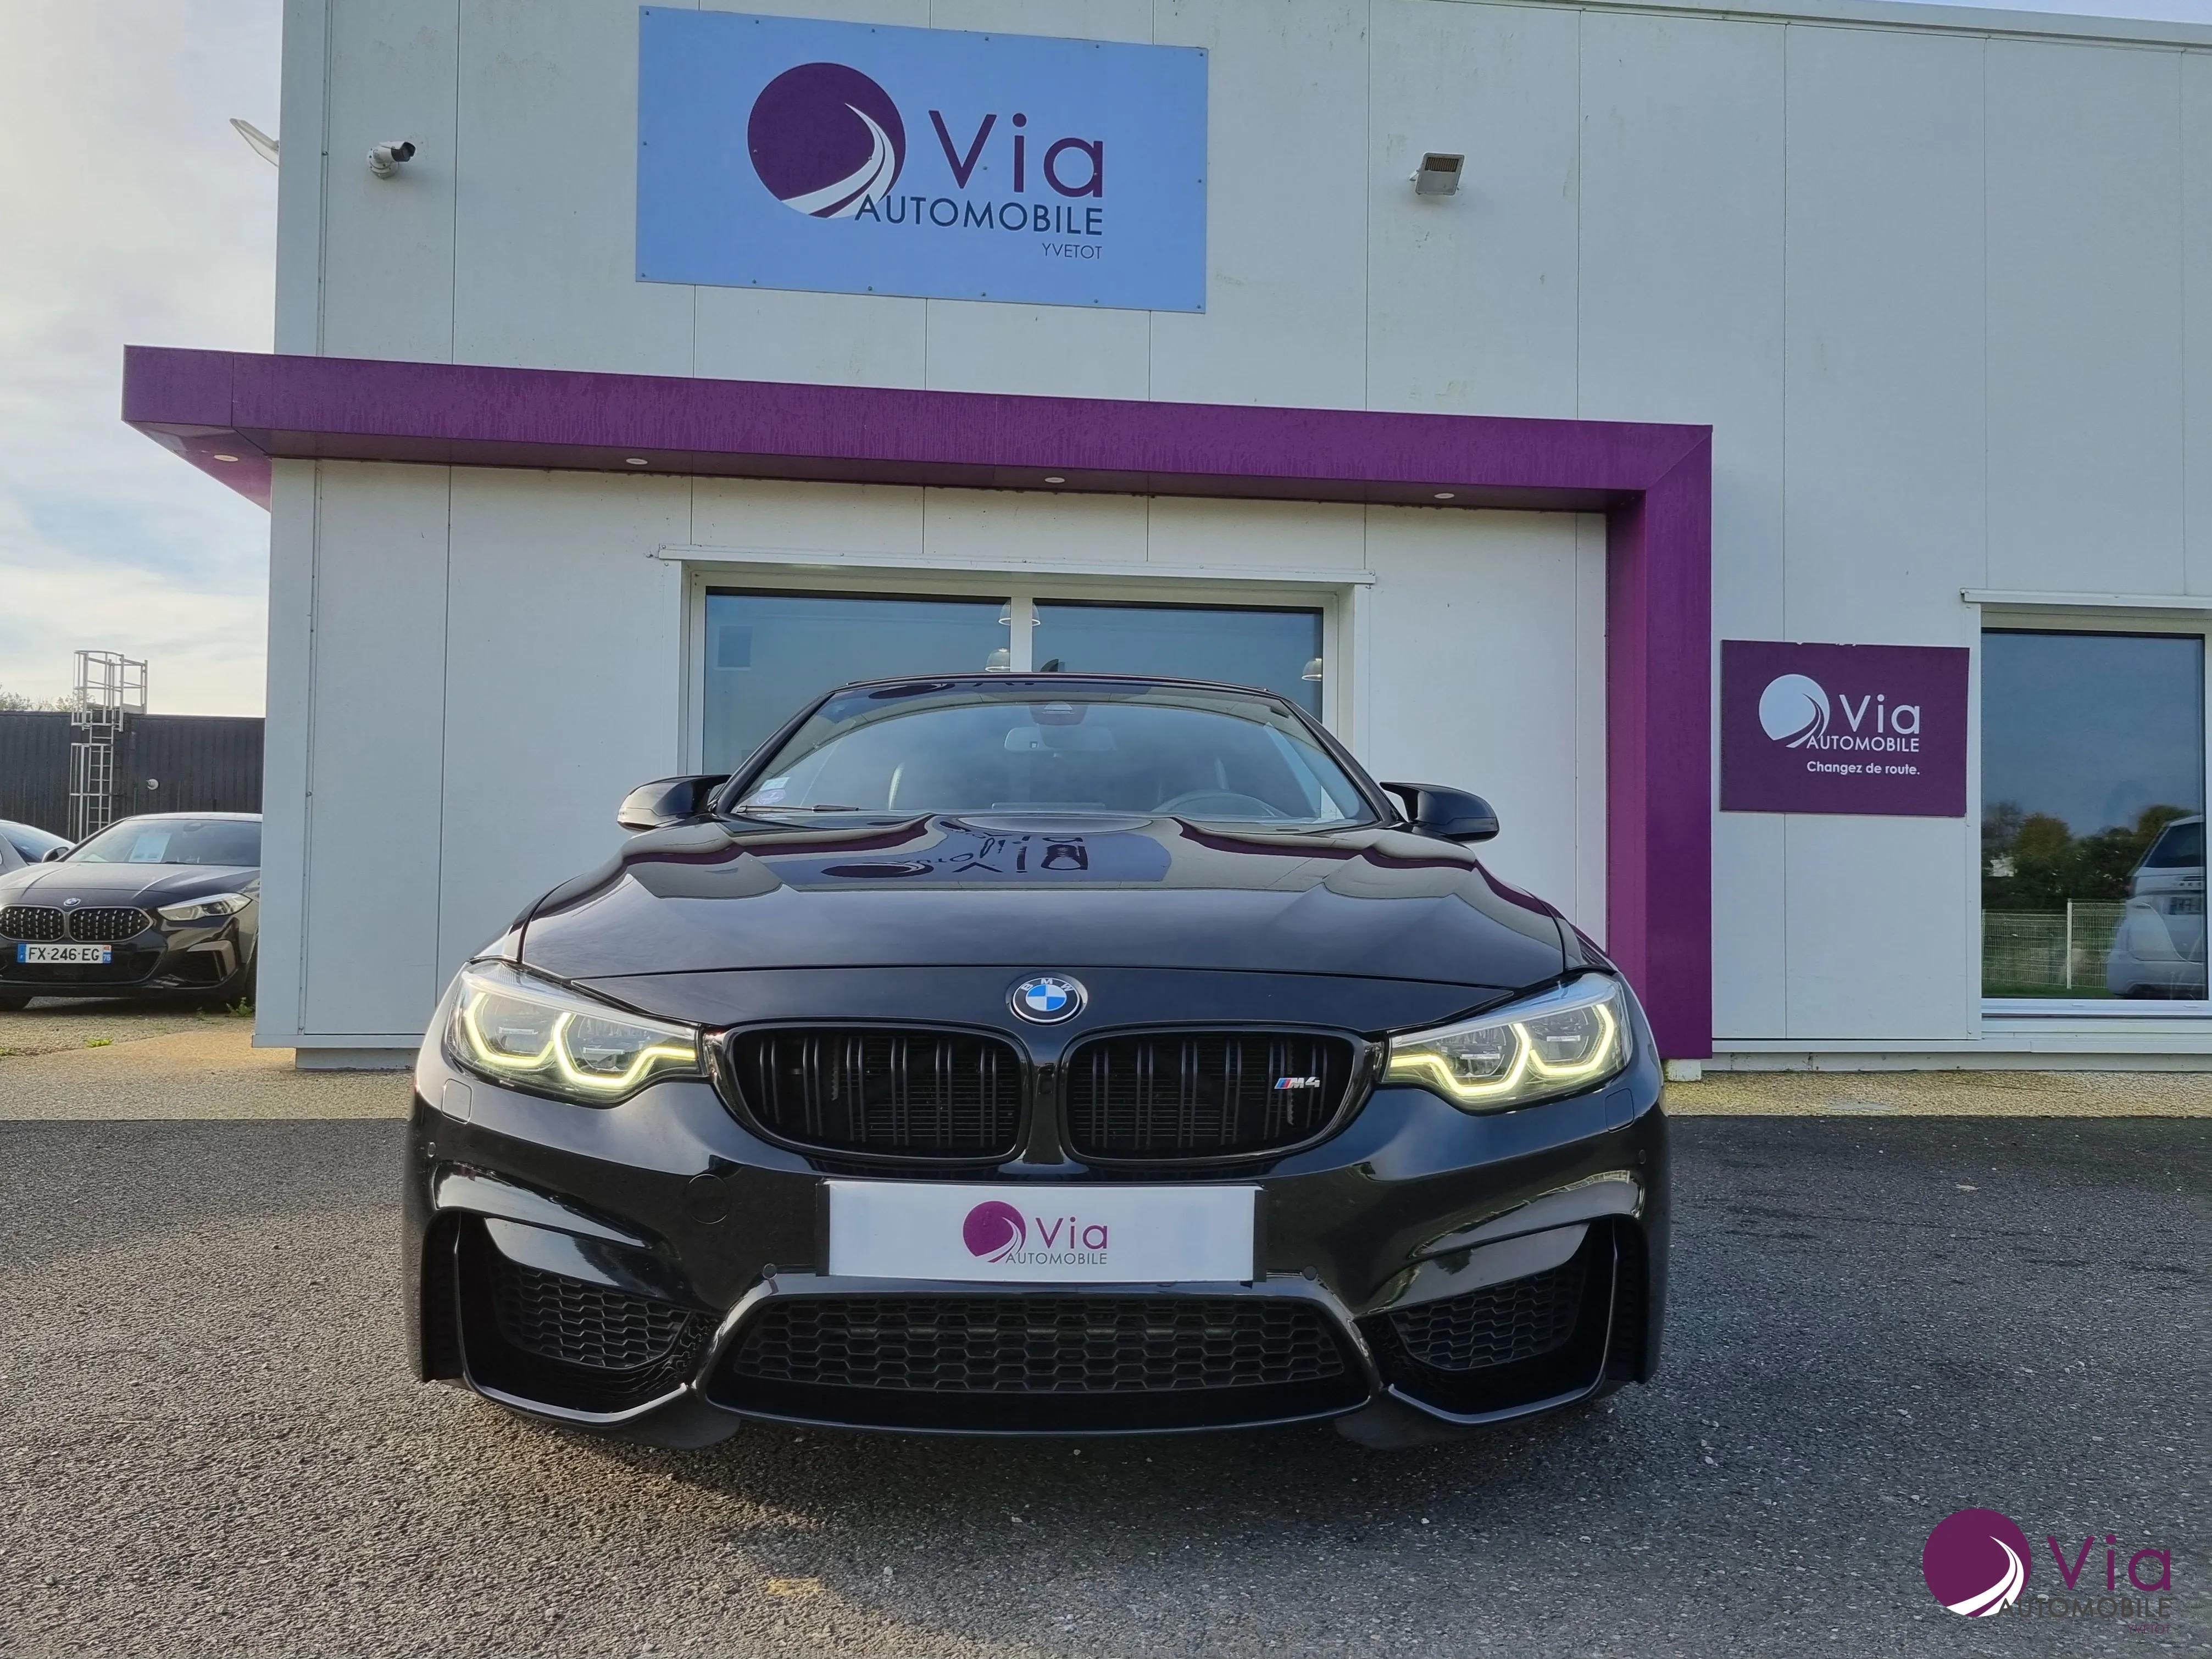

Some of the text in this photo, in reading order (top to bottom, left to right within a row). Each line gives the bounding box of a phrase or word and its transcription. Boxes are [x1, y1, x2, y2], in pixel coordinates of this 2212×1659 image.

[928, 110, 1103, 198] Via
[854, 193, 1103, 236] AUTOMOBILE
[1041, 242, 1103, 260] YVETOT
[1838, 694, 1920, 734] Via
[1806, 735, 1920, 752] AUTOMOBILE
[1807, 761, 1921, 775] Changez de route.
[1020, 978, 1075, 992] BMW
[1288, 1076, 1320, 1088] M4
[1035, 1216, 1108, 1250] Via
[1005, 1252, 1107, 1265] AUTOMOBILE
